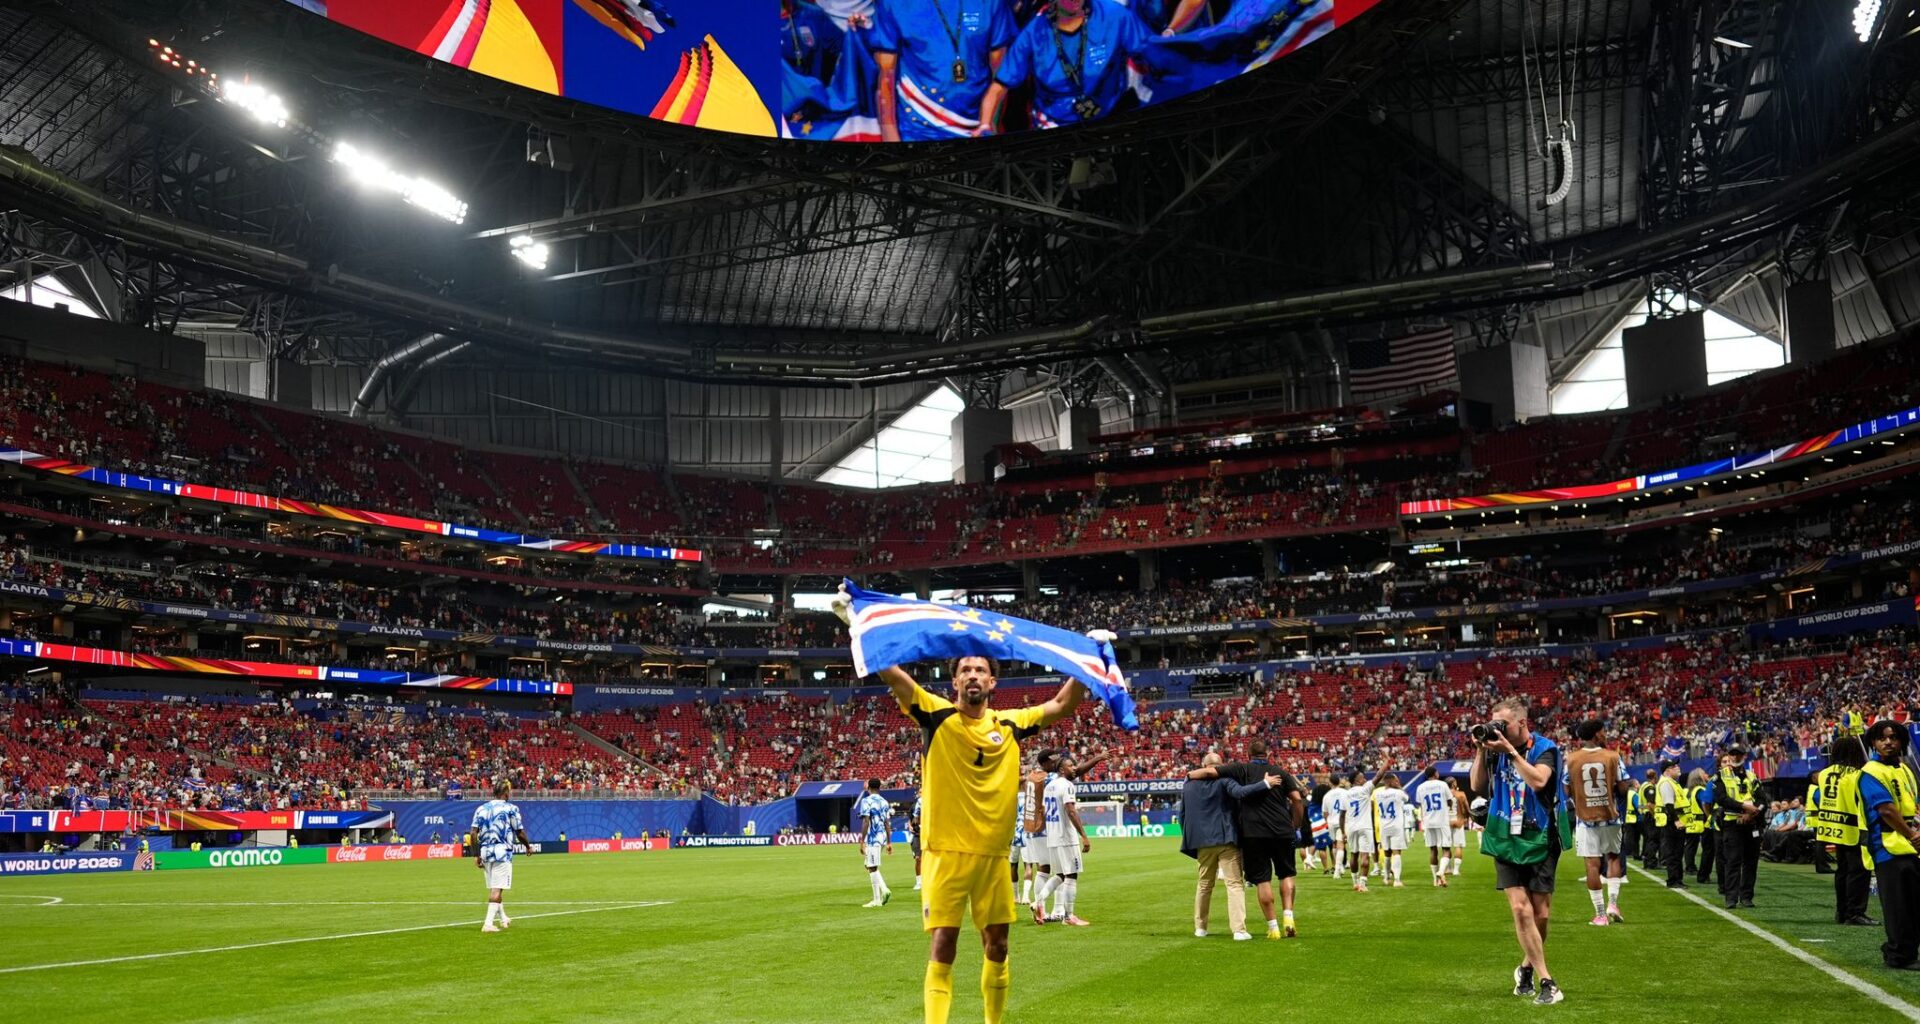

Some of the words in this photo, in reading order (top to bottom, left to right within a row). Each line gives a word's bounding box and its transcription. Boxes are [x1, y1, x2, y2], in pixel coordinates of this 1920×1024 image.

[1861, 550, 1879, 560] FIFA
[1880, 543, 1910, 556] WORLD
[0, 582, 49, 596] LANTA
[1358, 611, 1416, 621] ATLANTA
[1799, 616, 1815, 626] FIFA
[1814, 612, 1843, 623] WORLD
[1843, 609, 1859, 618] CUP
[1860, 604, 1889, 616] 2026
[369, 625, 423, 636] ATLANTA
[1167, 626, 1191, 634] WORLD
[1207, 623, 1233, 631] 2026
[536, 640, 550, 648] FIFA
[550, 642, 572, 650] WORLD
[1168, 667, 1220, 676] ATLANTA
[610, 687, 636, 695] WORLD
[1090, 783, 1127, 792] WORLD
[1127, 782, 1148, 790] CUP
[1149, 780, 1184, 790] 2026
[1424, 792, 1442, 812] 15
[1378, 801, 1396, 819] 14
[424, 816, 444, 824] FIFA
[1096, 824, 1164, 837] aramco
[686, 837, 706, 846] ADI
[708, 837, 770, 845] PREDICTSTREET
[778, 834, 816, 846] QATAR
[582, 841, 610, 852] Lenovo
[4, 860, 50, 871] WORLD
[52, 859, 77, 870] CUP
[78, 857, 119, 869] 2026
[209, 849, 282, 867] aramco
